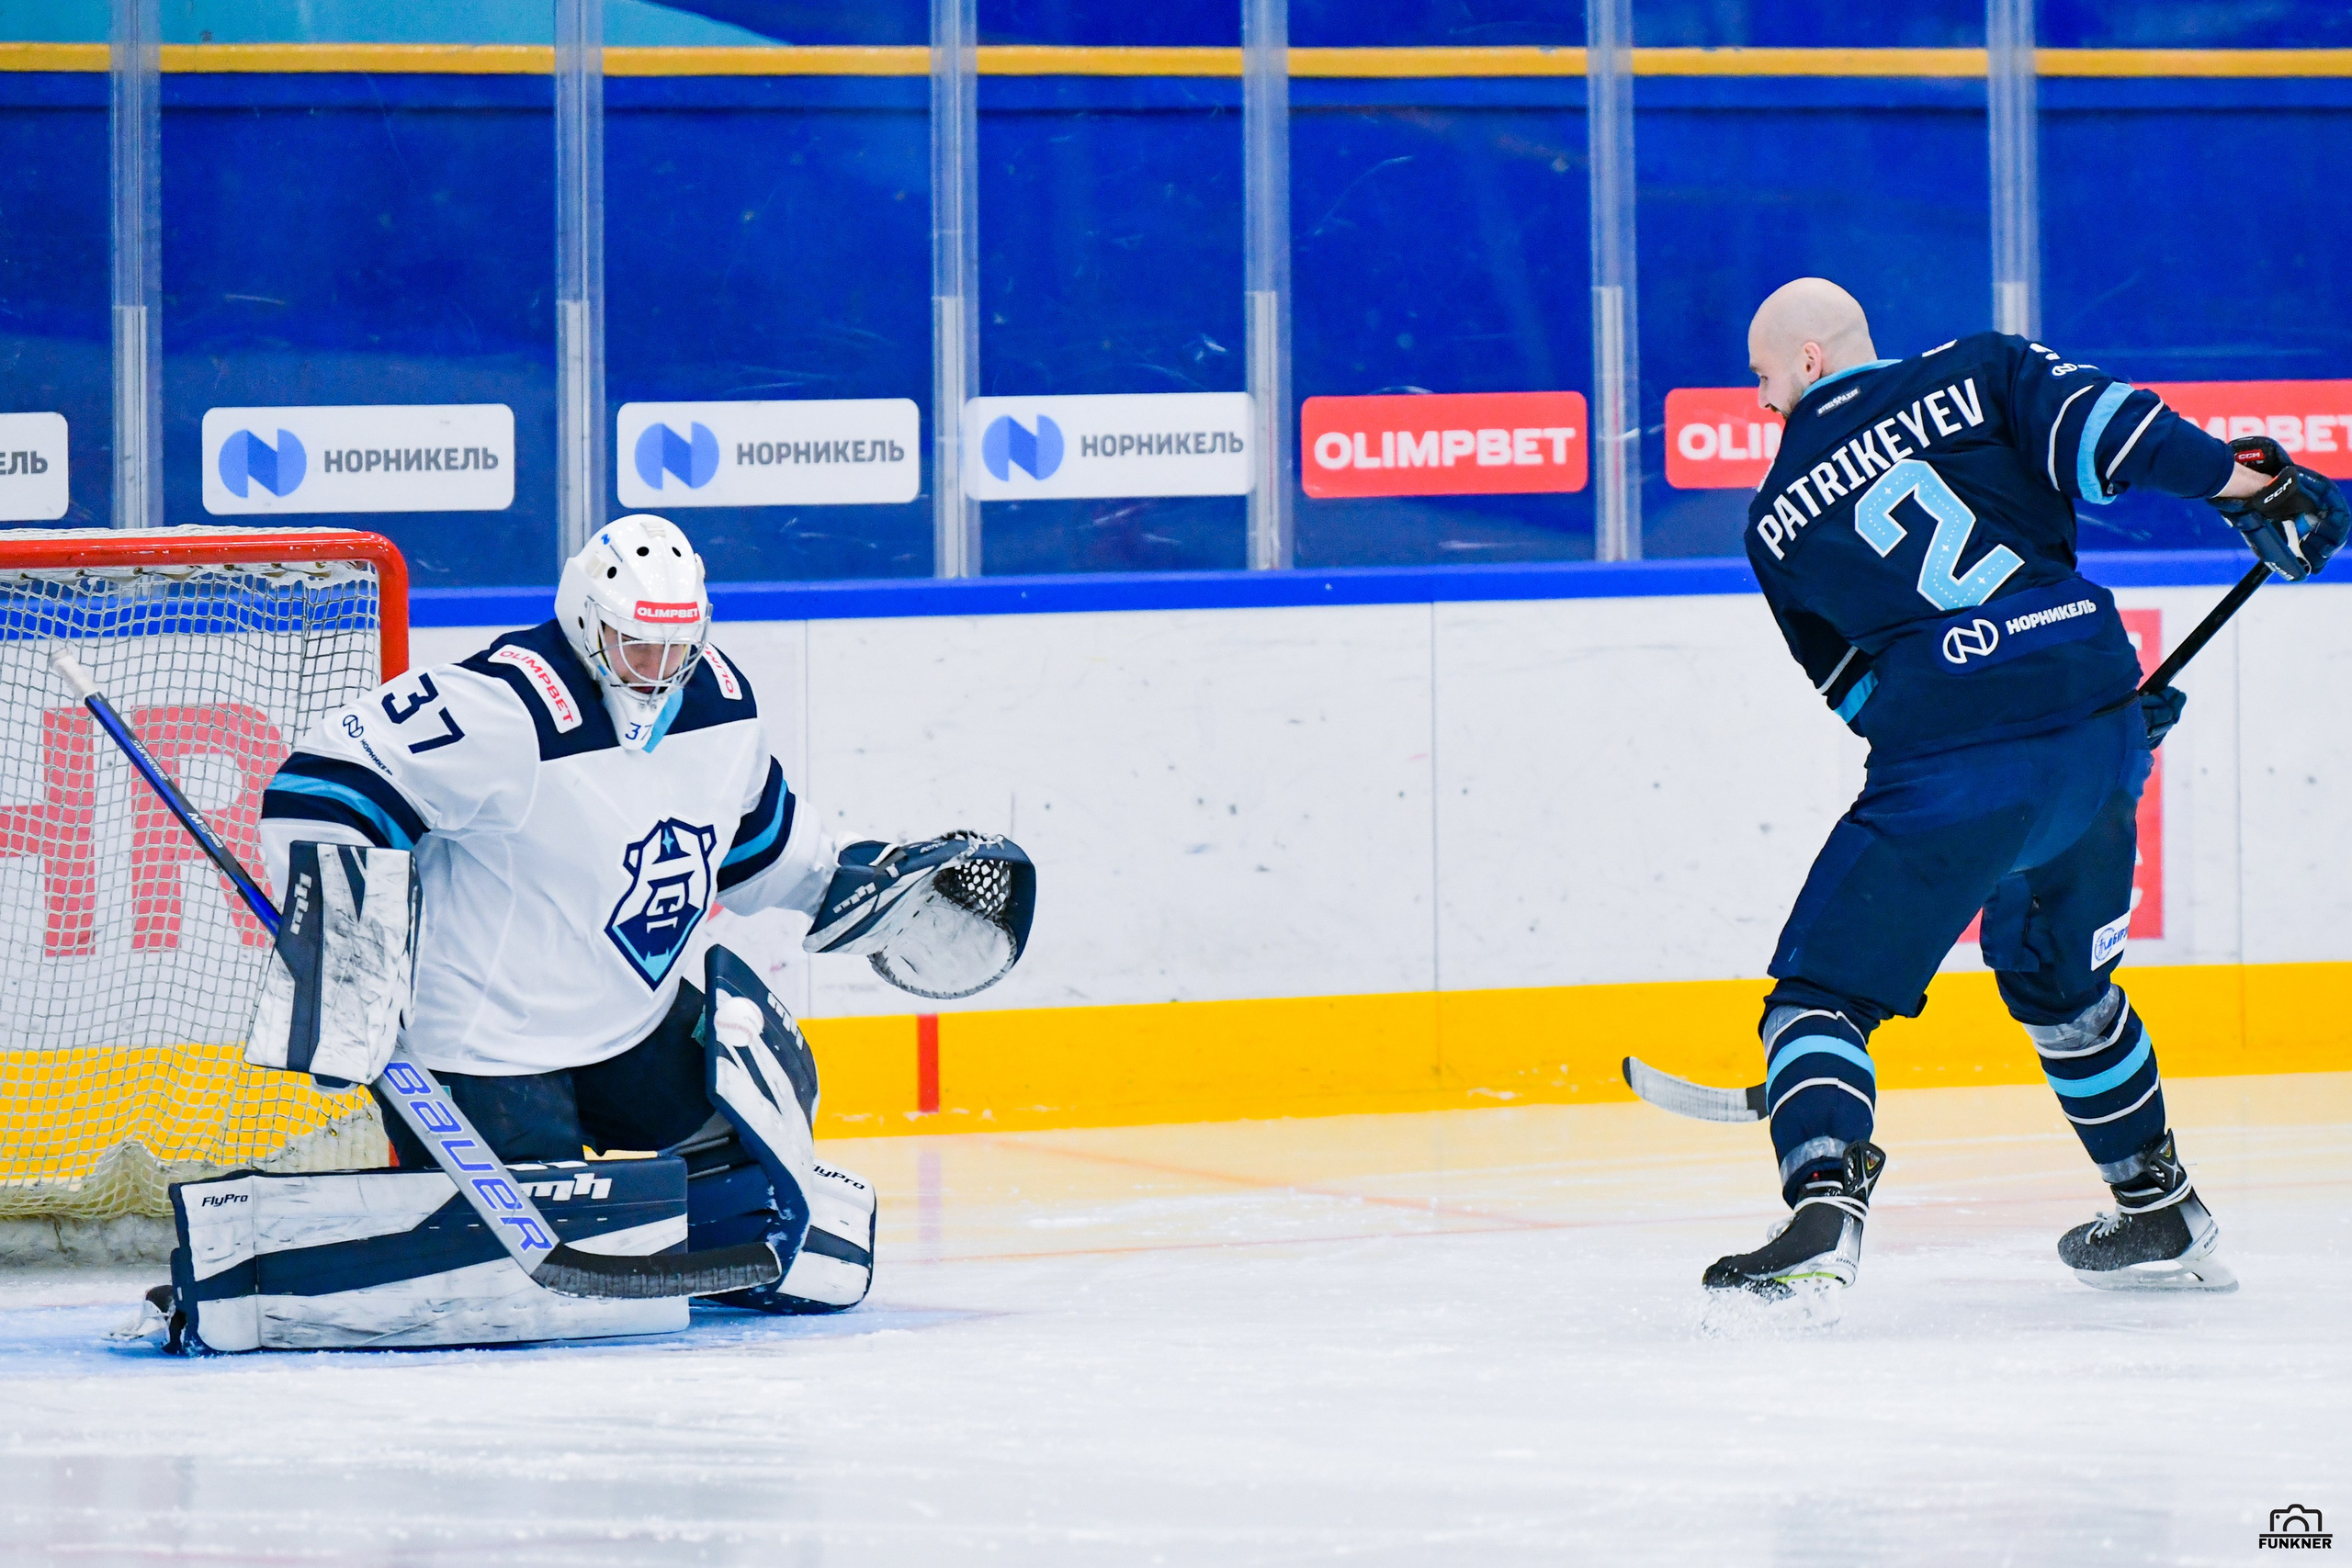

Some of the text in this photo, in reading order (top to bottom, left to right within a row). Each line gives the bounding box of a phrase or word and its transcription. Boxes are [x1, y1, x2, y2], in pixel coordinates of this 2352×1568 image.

[737, 439, 905, 465] НОРНИКЕЛЬ
[1080, 431, 1244, 457] НОРНИКЕЛЬ
[1314, 427, 1576, 470] OLIMPBET
[324, 447, 499, 473] НОРНИКЕЛЬ
[1756, 378, 1984, 560] PATRIKEYEV
[2263, 477, 2292, 504] CCM
[1854, 458, 2025, 612] 2
[637, 606, 699, 619] OLIMPBET
[2005, 599, 2098, 636] НОРНИКЕЛЬ
[500, 650, 573, 723] OLIMPBET
[381, 672, 465, 754] 37
[625, 722, 653, 741] 37
[383, 1061, 553, 1252] BAUER
[813, 1164, 865, 1190] lyPro
[201, 1194, 248, 1207] FlyPro
